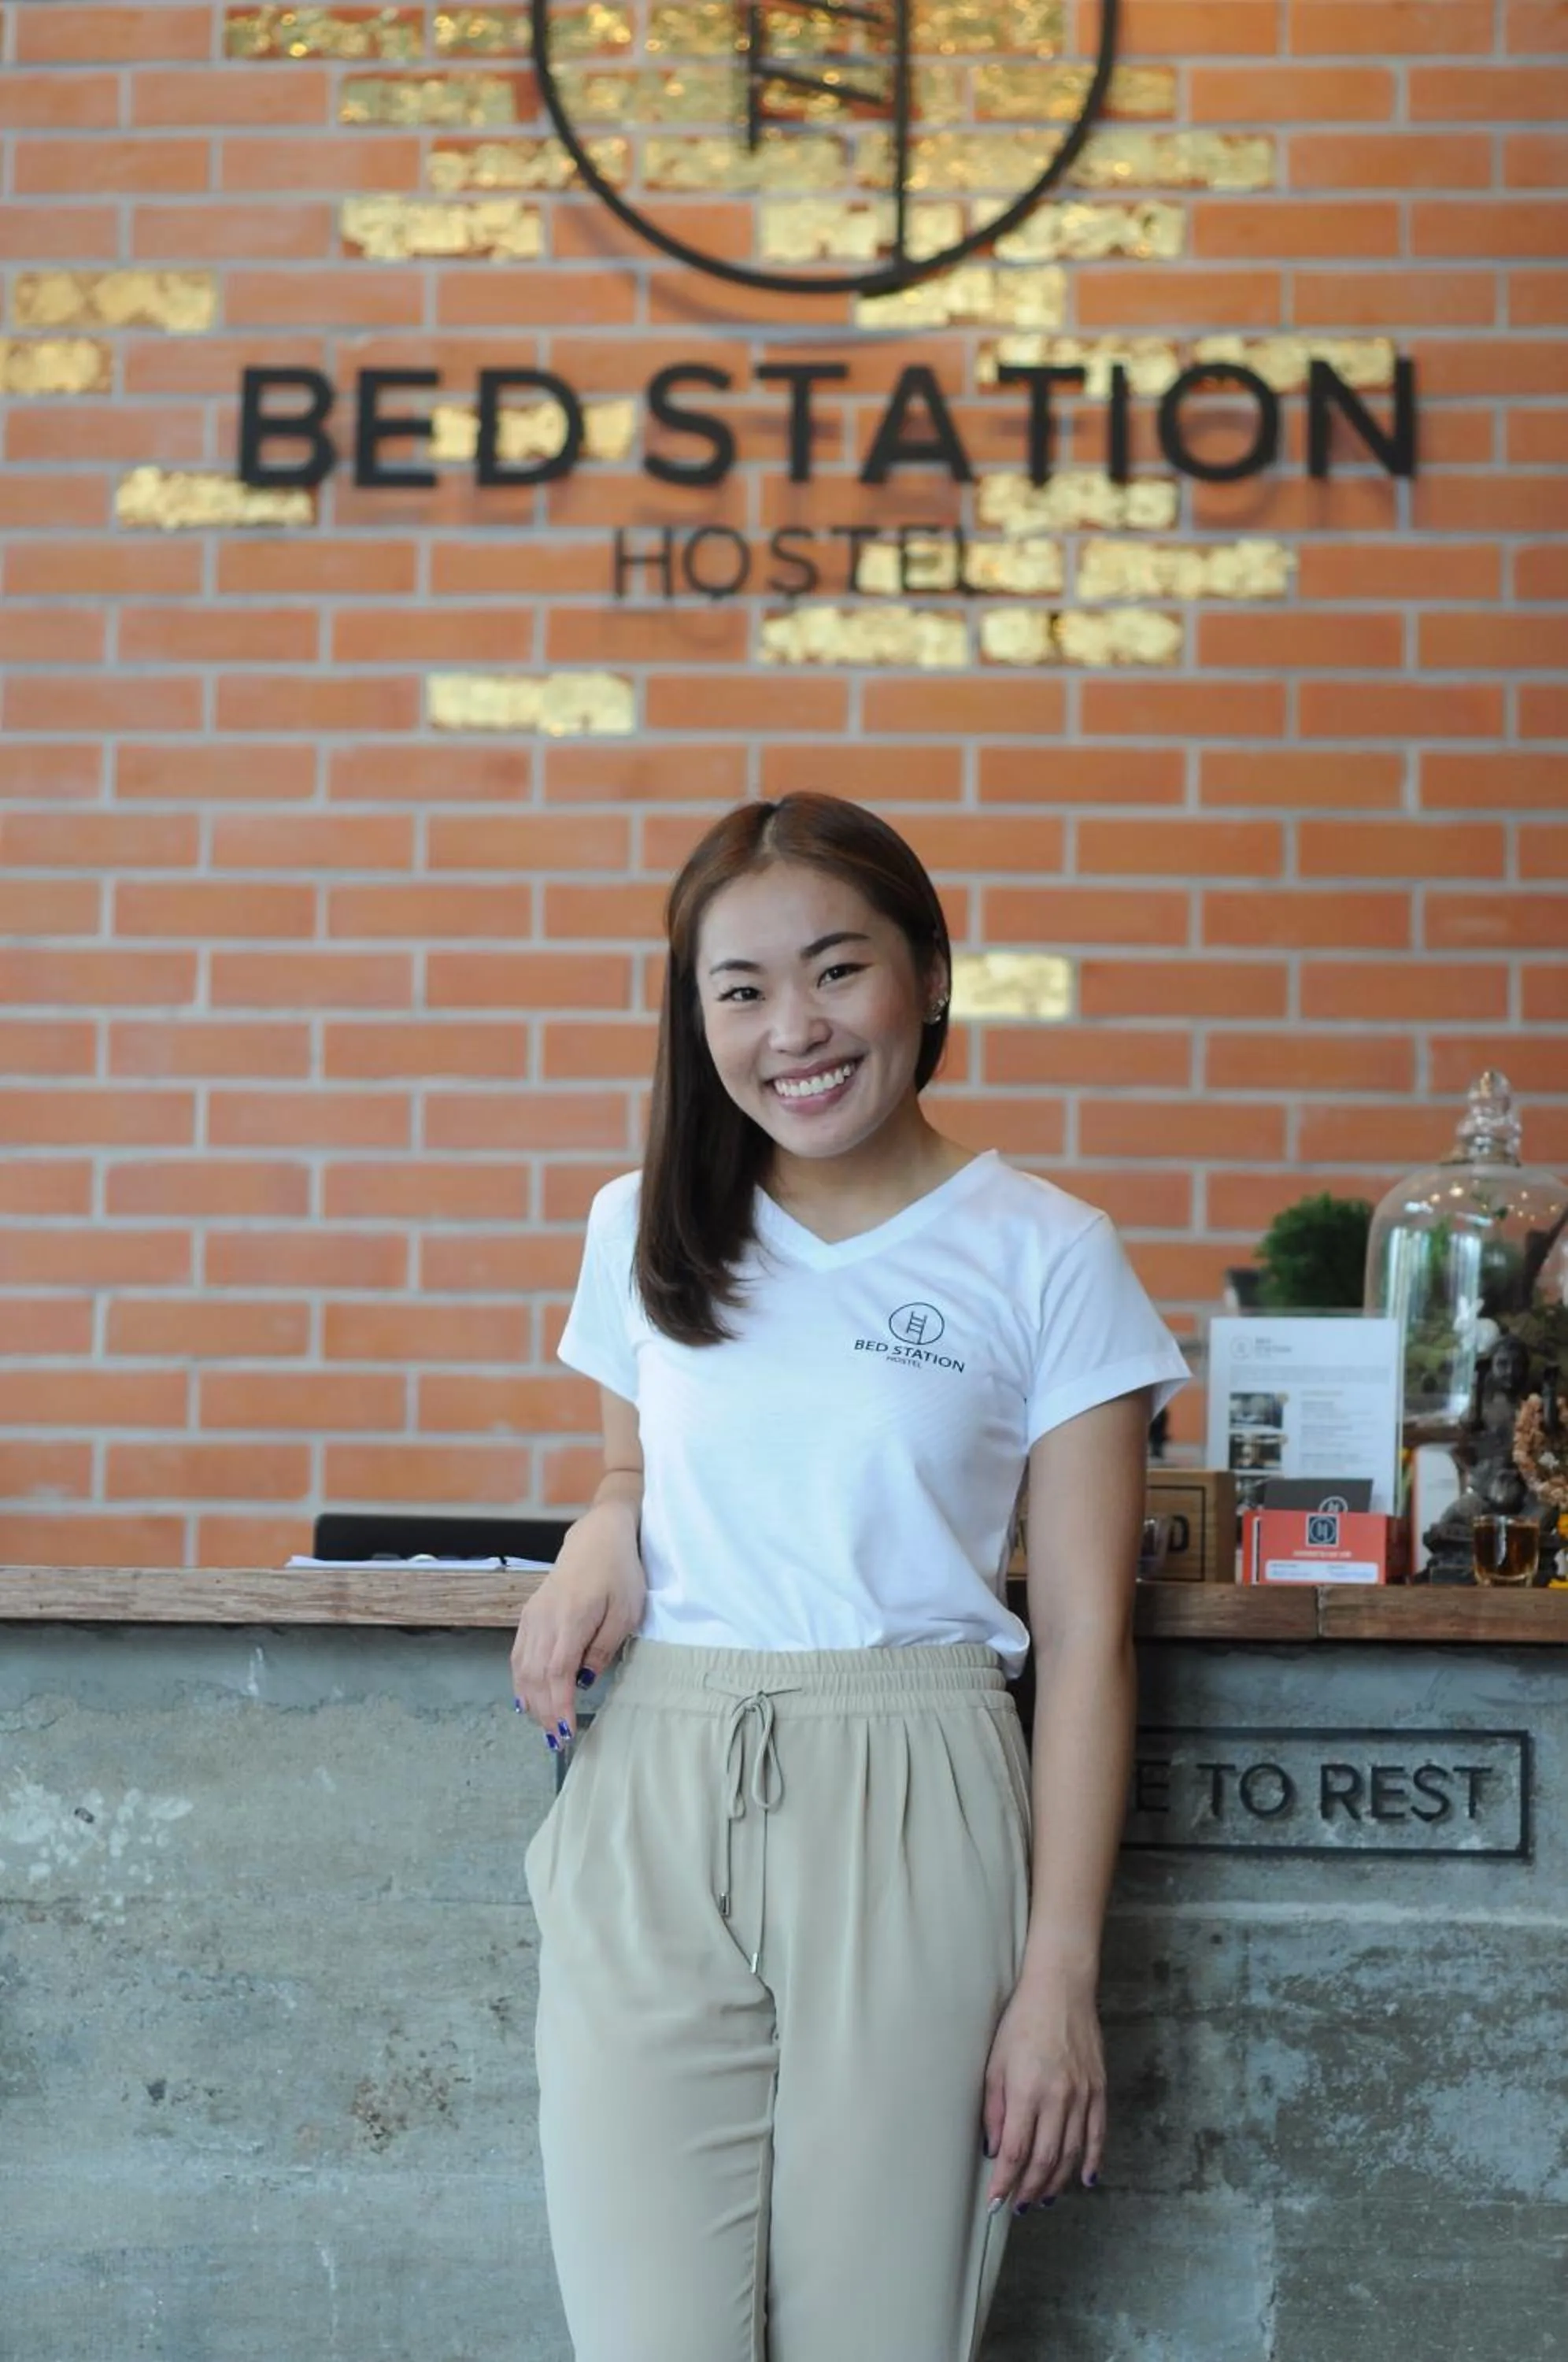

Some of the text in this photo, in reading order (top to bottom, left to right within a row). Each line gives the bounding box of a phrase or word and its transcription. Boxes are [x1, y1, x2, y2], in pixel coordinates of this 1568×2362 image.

[239, 356, 1416, 490] BED STATION
[613, 524, 984, 600] HOSTEL
[854, 1339, 965, 1373] BED STATION
[886, 1356, 921, 1368] HOSTEL
[1196, 1762, 1290, 1818] TO
[1320, 1762, 1492, 1821] REST
